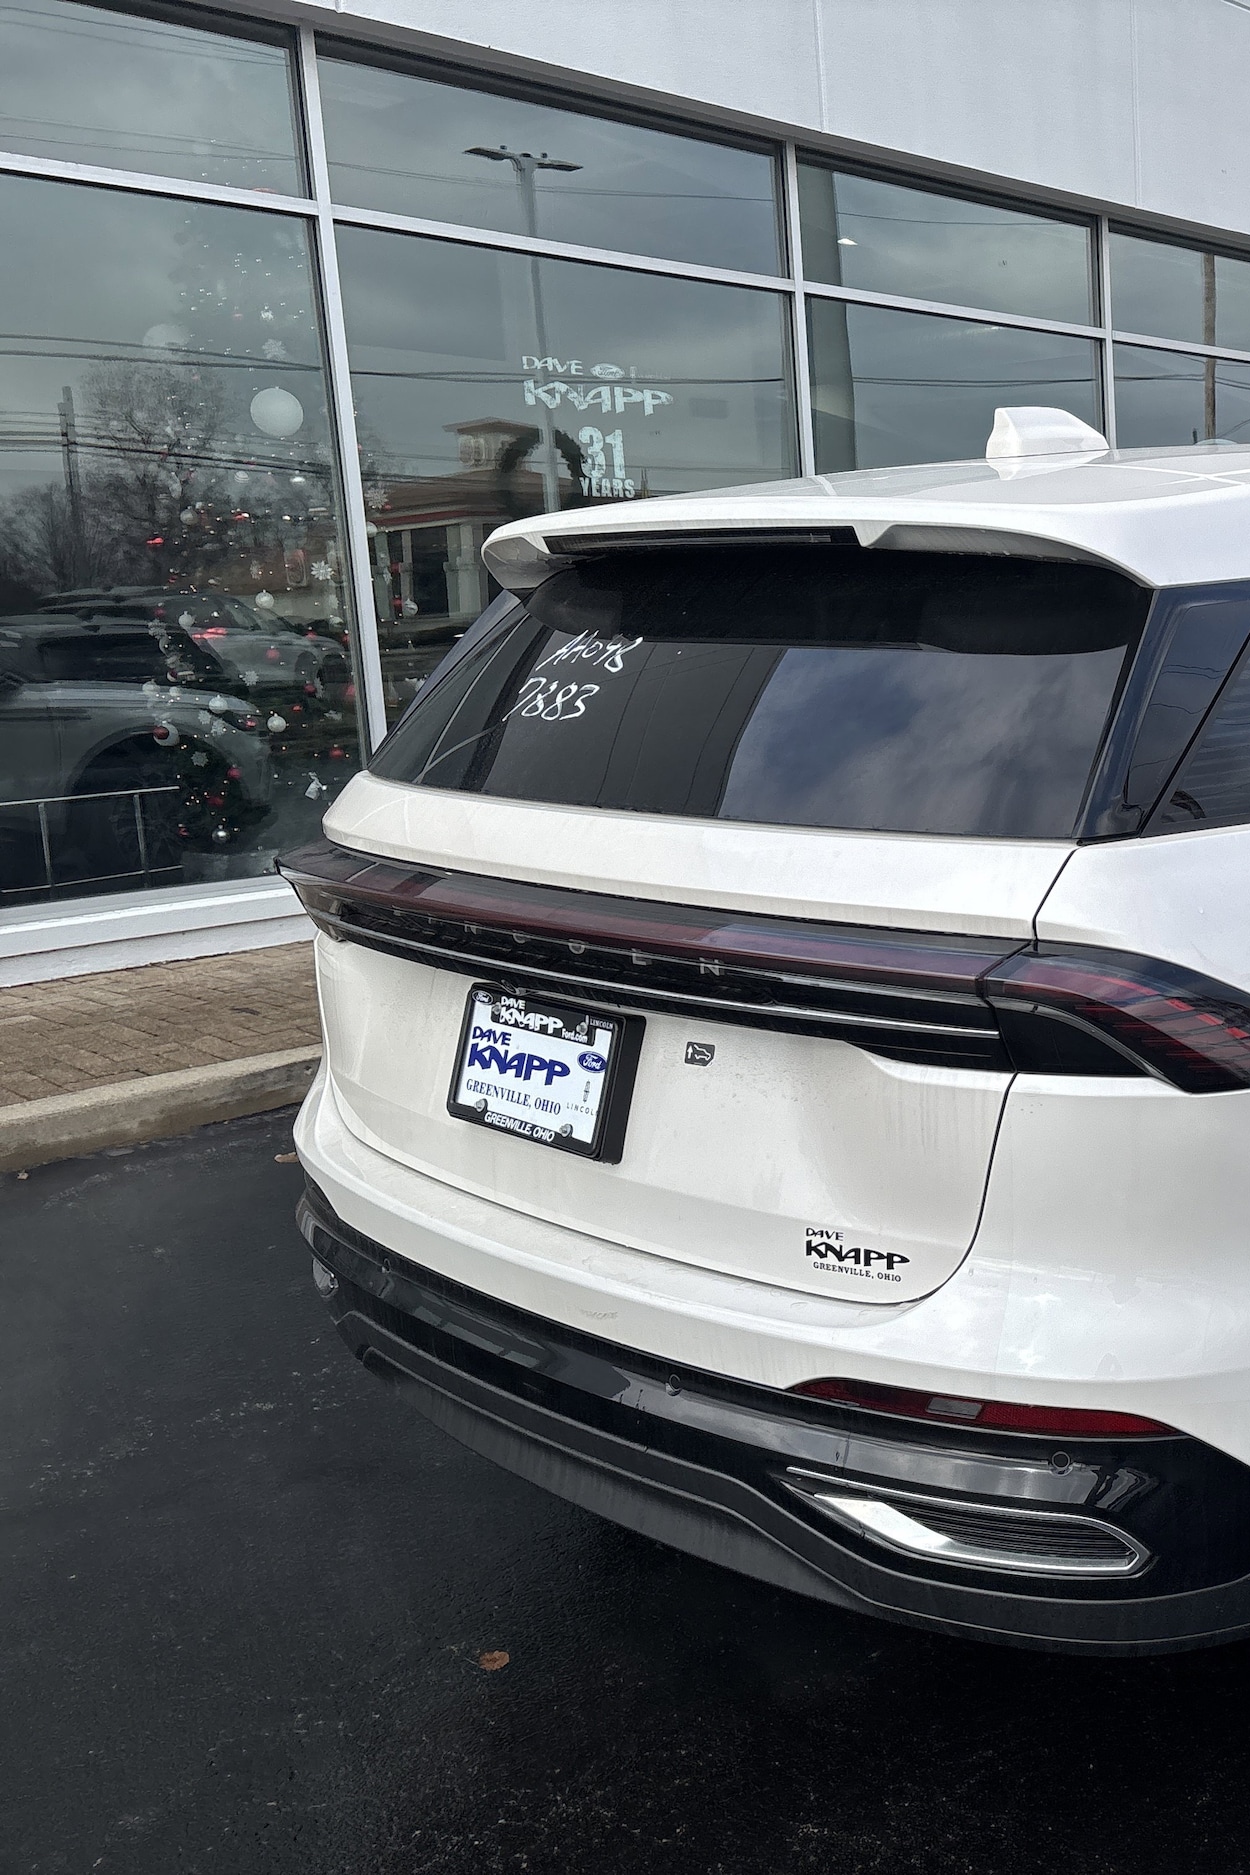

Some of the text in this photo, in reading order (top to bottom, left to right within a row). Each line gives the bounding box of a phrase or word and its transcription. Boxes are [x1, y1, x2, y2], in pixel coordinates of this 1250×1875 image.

[521, 355, 584, 375] DAVE
[523, 379, 674, 417] KNAPP
[578, 426, 626, 479] 31
[579, 476, 636, 498] YEARS
[500, 996, 526, 1010] DAVE
[499, 1006, 564, 1035] KNAPP
[471, 1026, 512, 1047] DAVE
[561, 1029, 588, 1044] Ford.com
[467, 1042, 571, 1087] KNAPP
[466, 1078, 562, 1116] GREENVILLE, OHIO
[532, 1126, 555, 1143] OHIO
[805, 1227, 844, 1241] DAVE
[805, 1239, 911, 1270] KNAPP
[813, 1261, 902, 1283] GREENVILLE, OHIO
